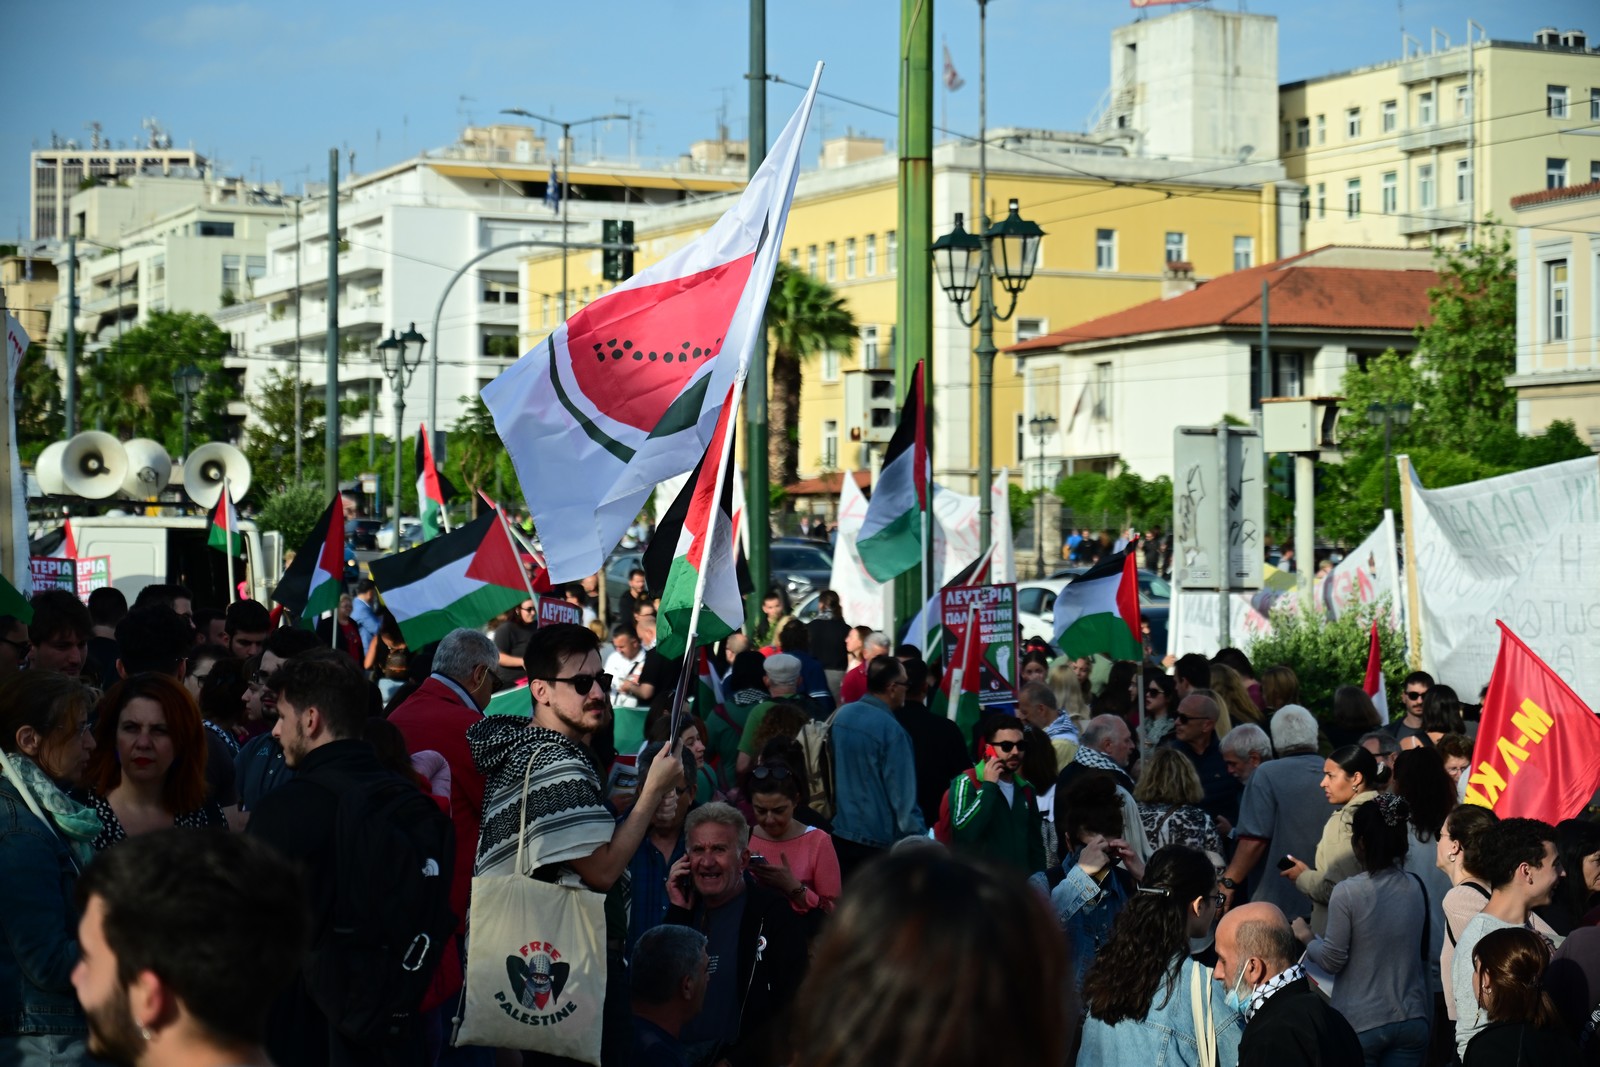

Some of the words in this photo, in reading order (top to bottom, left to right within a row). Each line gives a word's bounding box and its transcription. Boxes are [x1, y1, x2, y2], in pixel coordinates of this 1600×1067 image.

[31, 559, 73, 575] ΤΕΡΙΑ
[77, 559, 105, 574] ΕΡΙΑ
[945, 608, 1013, 625] ΠΑΛΣΤΙΝΗ
[518, 941, 562, 962] FREE
[494, 991, 578, 1026] PALESTINE
